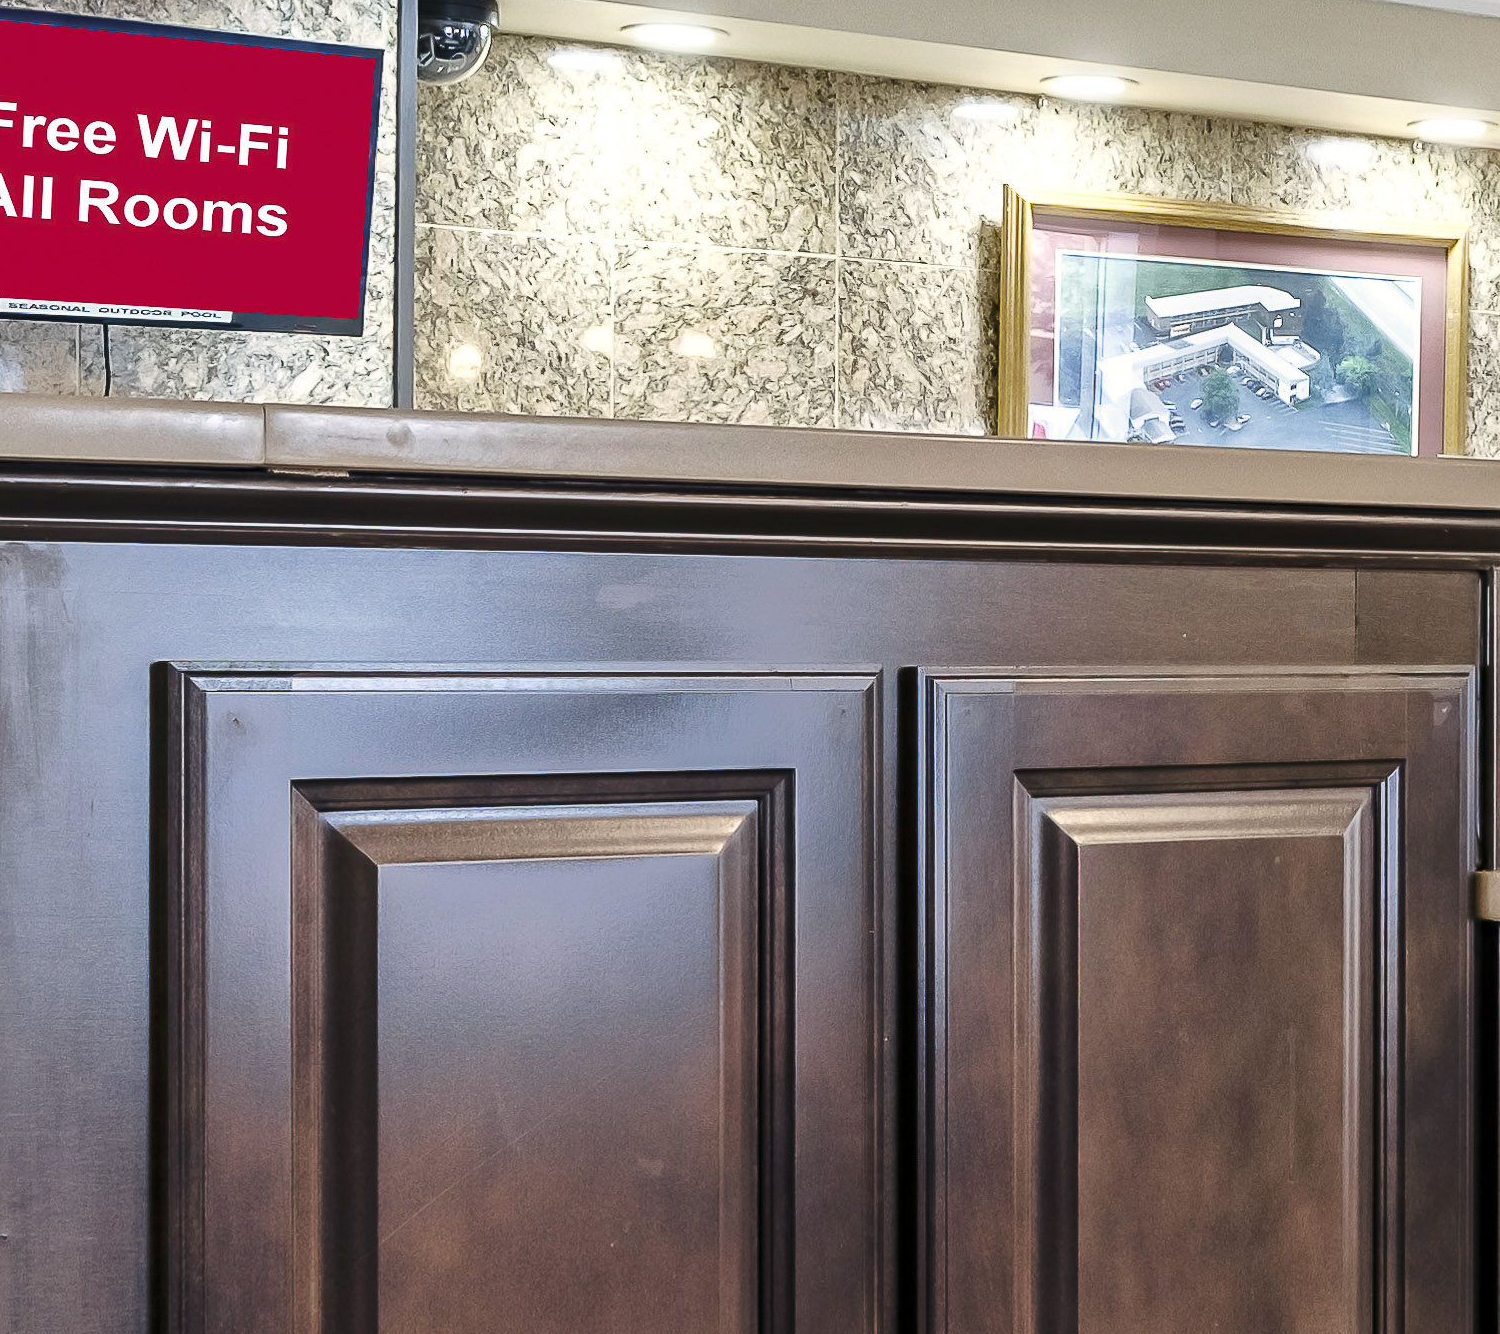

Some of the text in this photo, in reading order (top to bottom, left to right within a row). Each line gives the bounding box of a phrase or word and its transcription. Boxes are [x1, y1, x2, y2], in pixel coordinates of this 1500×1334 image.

[136, 113, 289, 169] Wi-Fi
[77, 179, 288, 237] Rooms
[8, 301, 223, 319] SEASONAL OUTDOOR POOL
